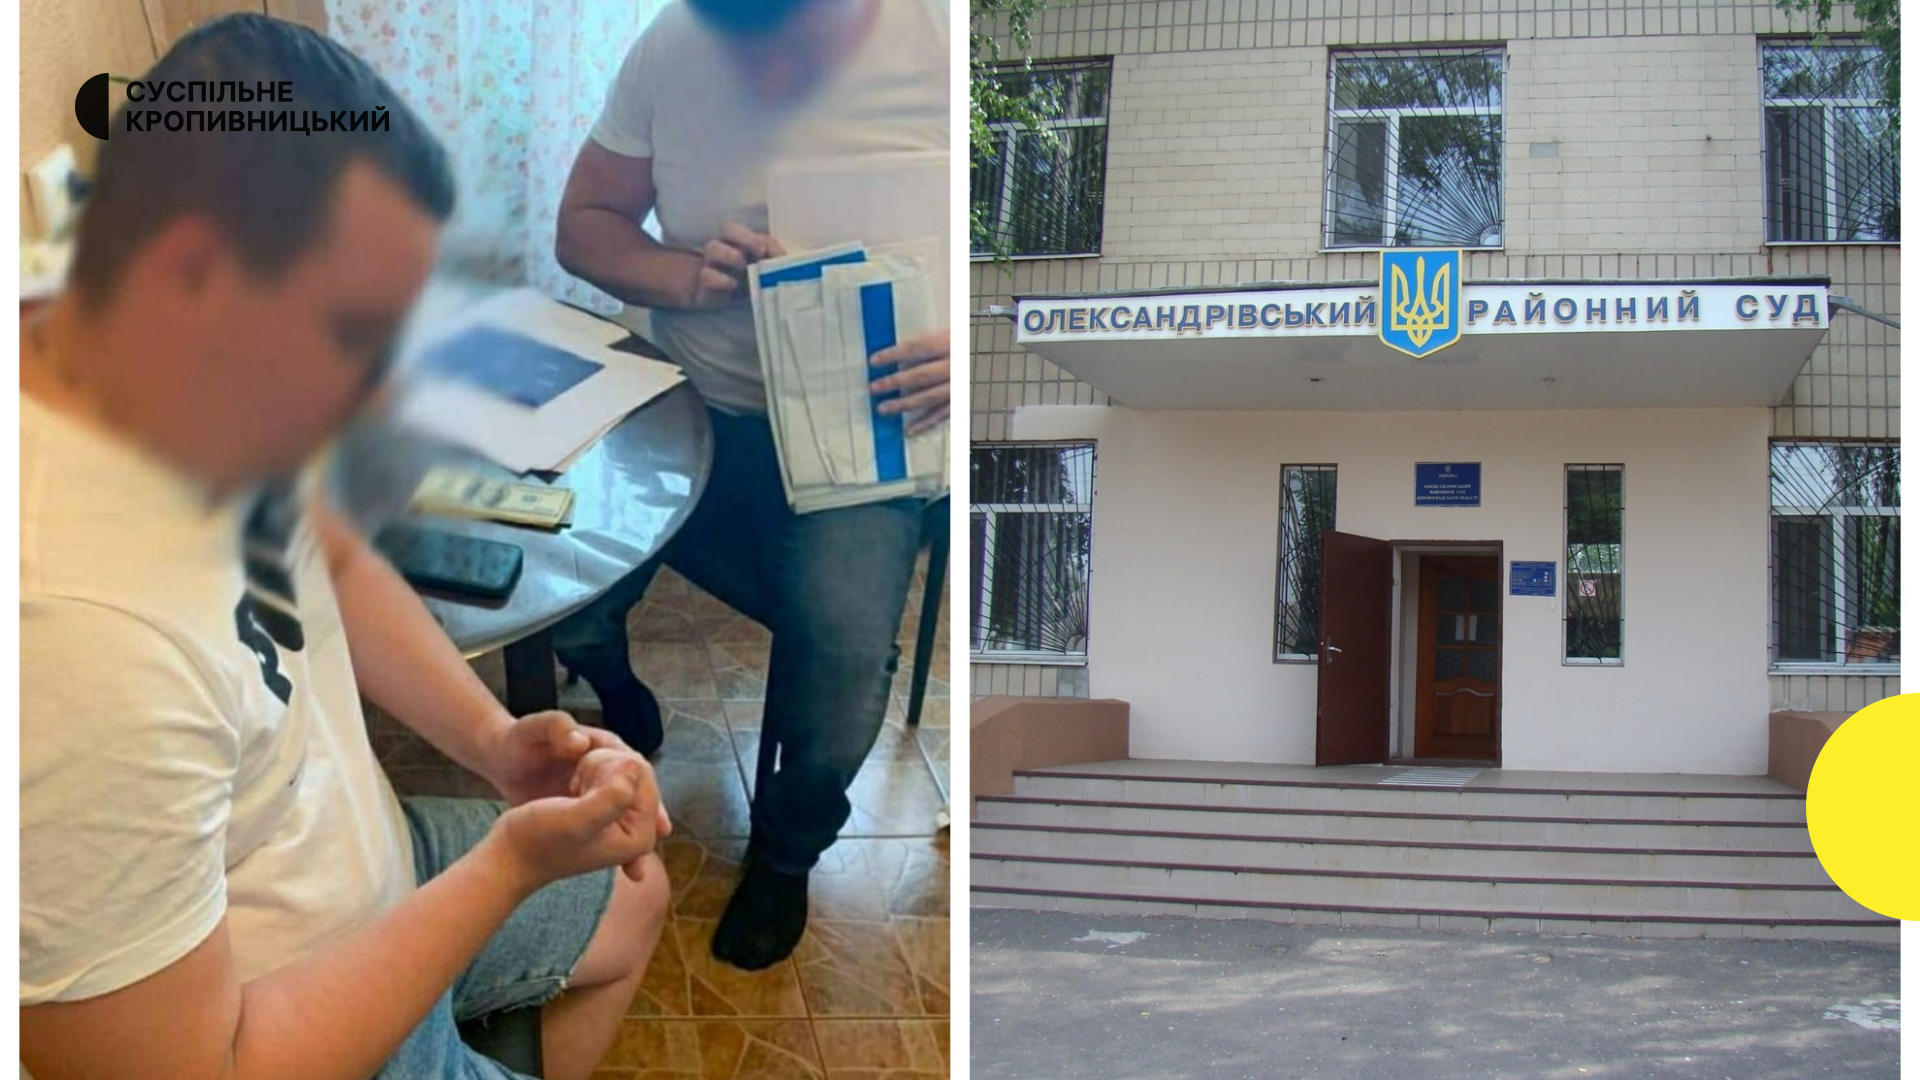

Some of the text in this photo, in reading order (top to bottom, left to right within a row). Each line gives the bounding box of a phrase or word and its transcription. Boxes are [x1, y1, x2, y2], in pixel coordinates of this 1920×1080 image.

[1023, 289, 1821, 335] ОЛЕКСАНДРІВСЬКИЙ РАЙОННИЙ СУД
